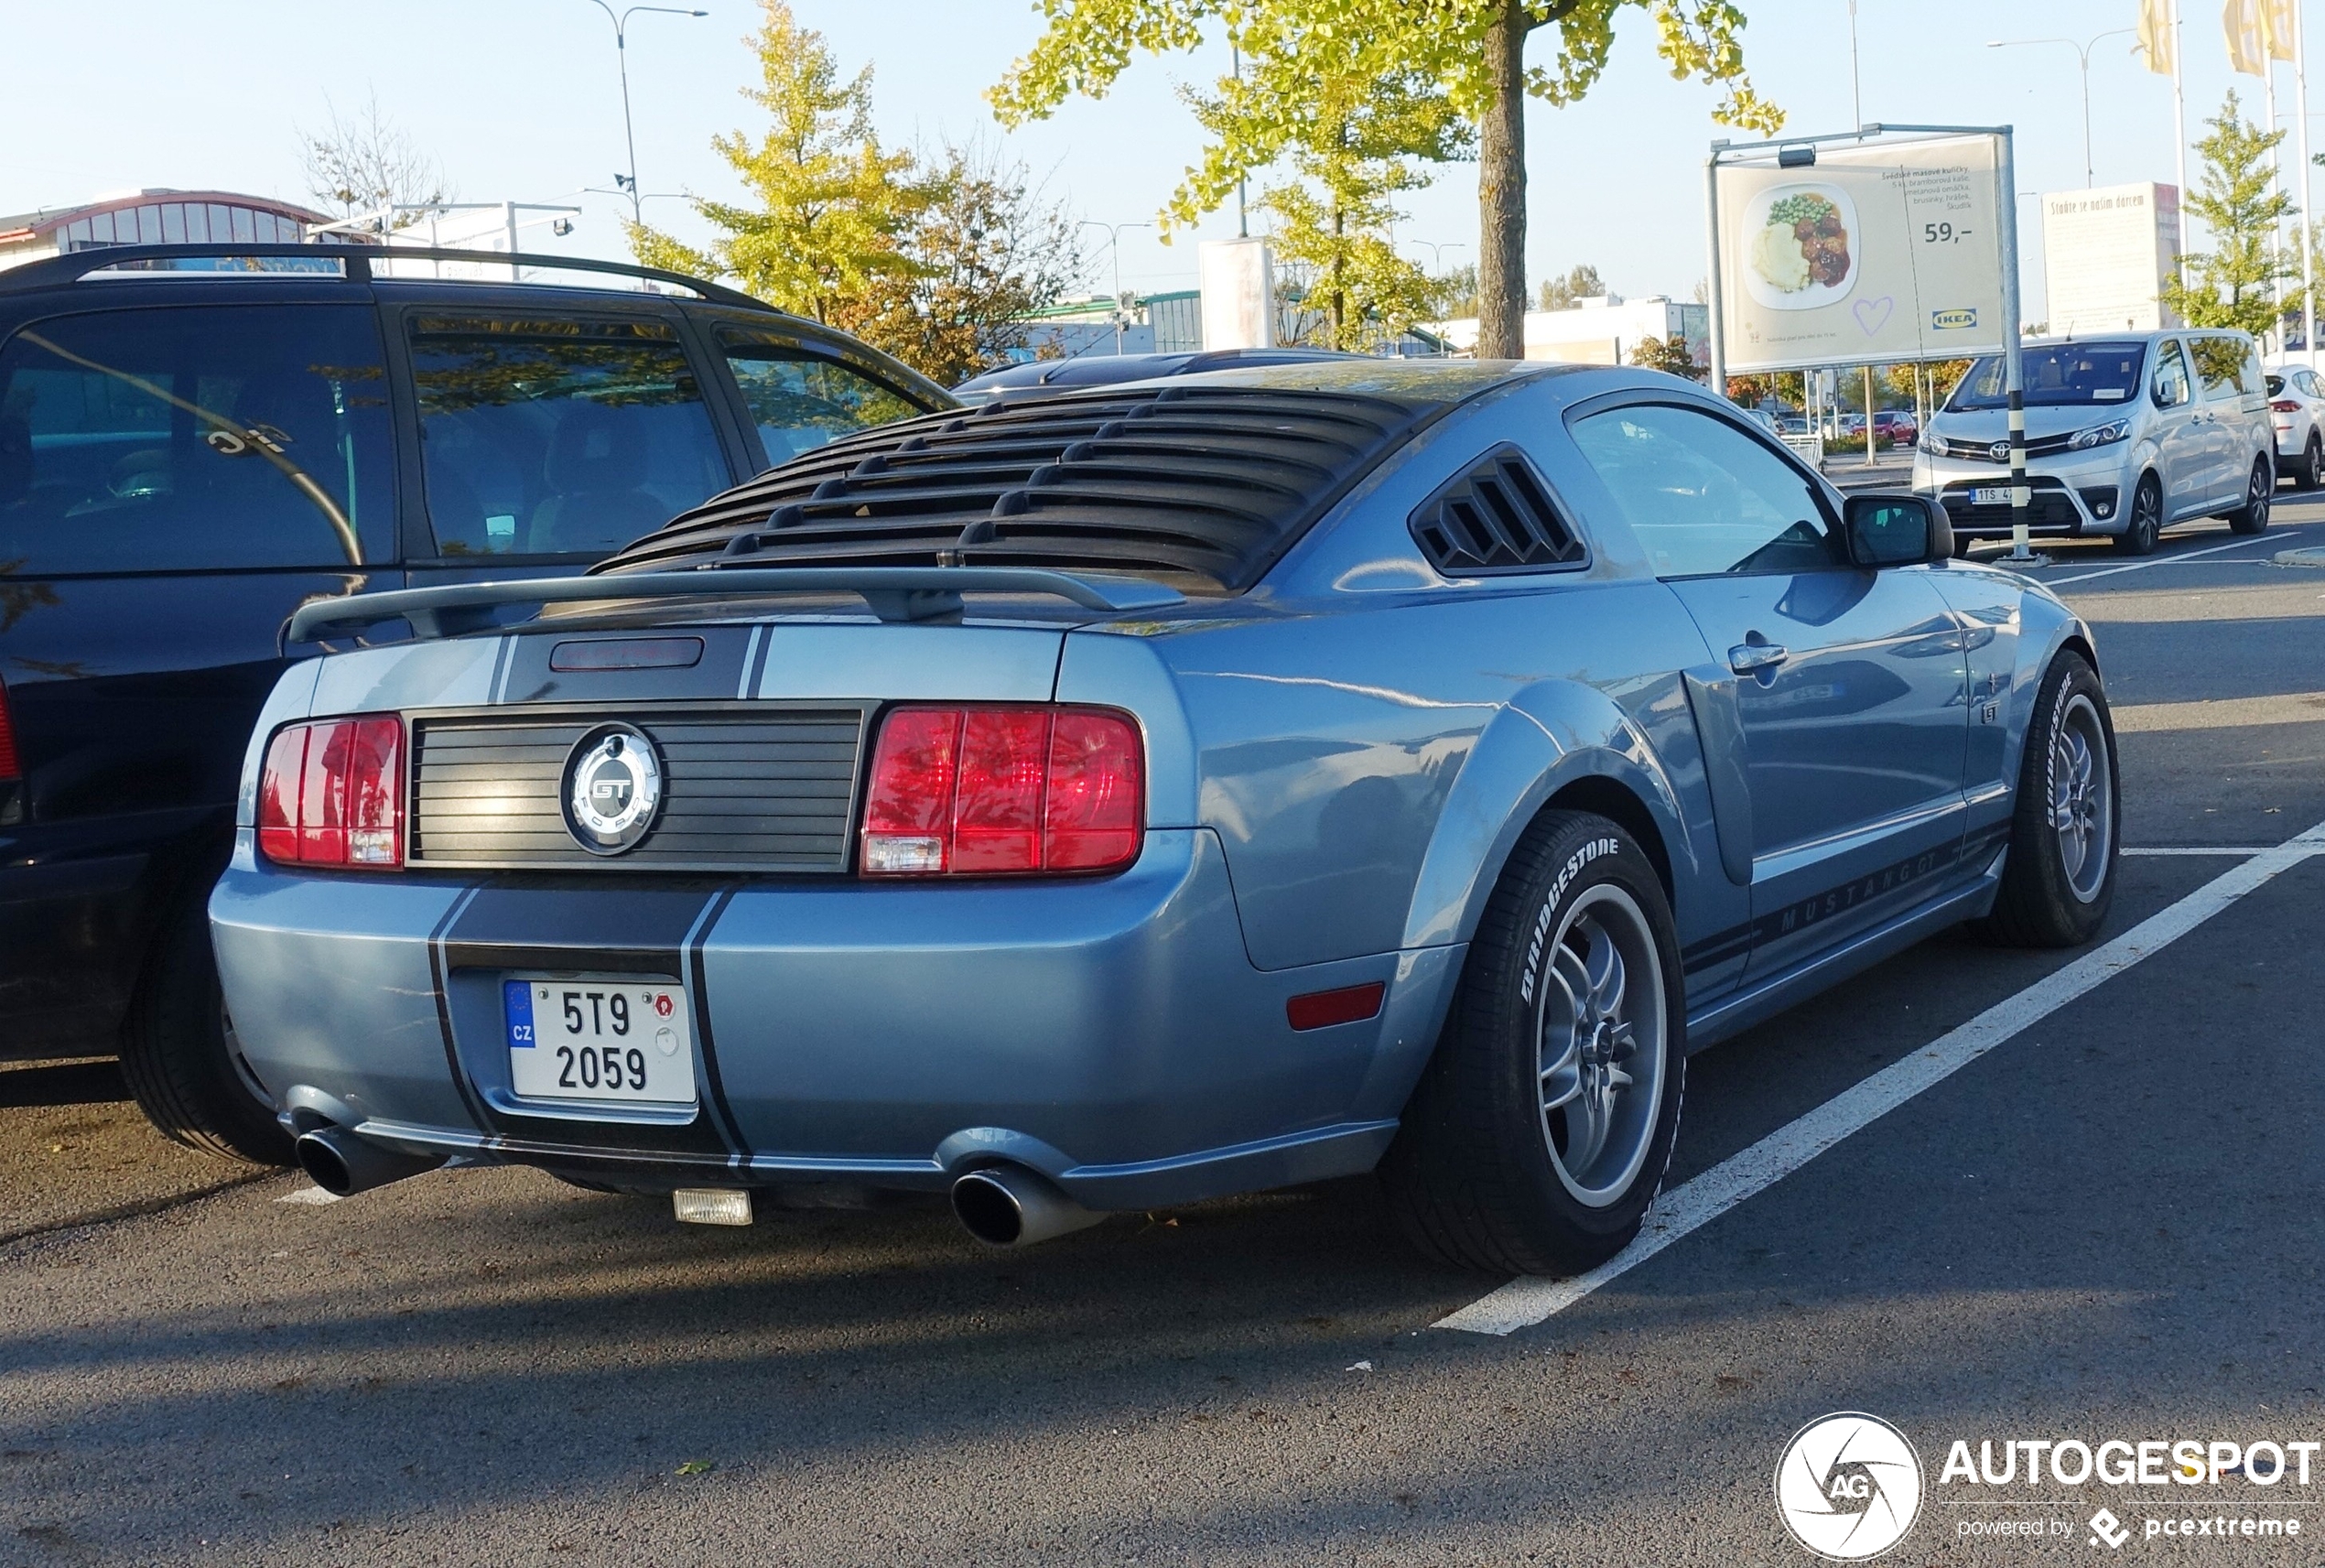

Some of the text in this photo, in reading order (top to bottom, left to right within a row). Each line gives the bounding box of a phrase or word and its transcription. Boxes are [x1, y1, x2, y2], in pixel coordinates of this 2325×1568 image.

[1913, 169, 1941, 178] masové
[2079, 200, 2088, 213] se
[1937, 314, 1974, 324] IKEA
[1979, 490, 1996, 501] 1TS
[592, 779, 631, 799] GT
[1781, 865, 1910, 933] MUSTANG
[1520, 838, 1619, 1007] BRIDGESTONE
[562, 992, 630, 1035] 5T9
[514, 1025, 533, 1041] CZ
[556, 1045, 646, 1090] 2059
